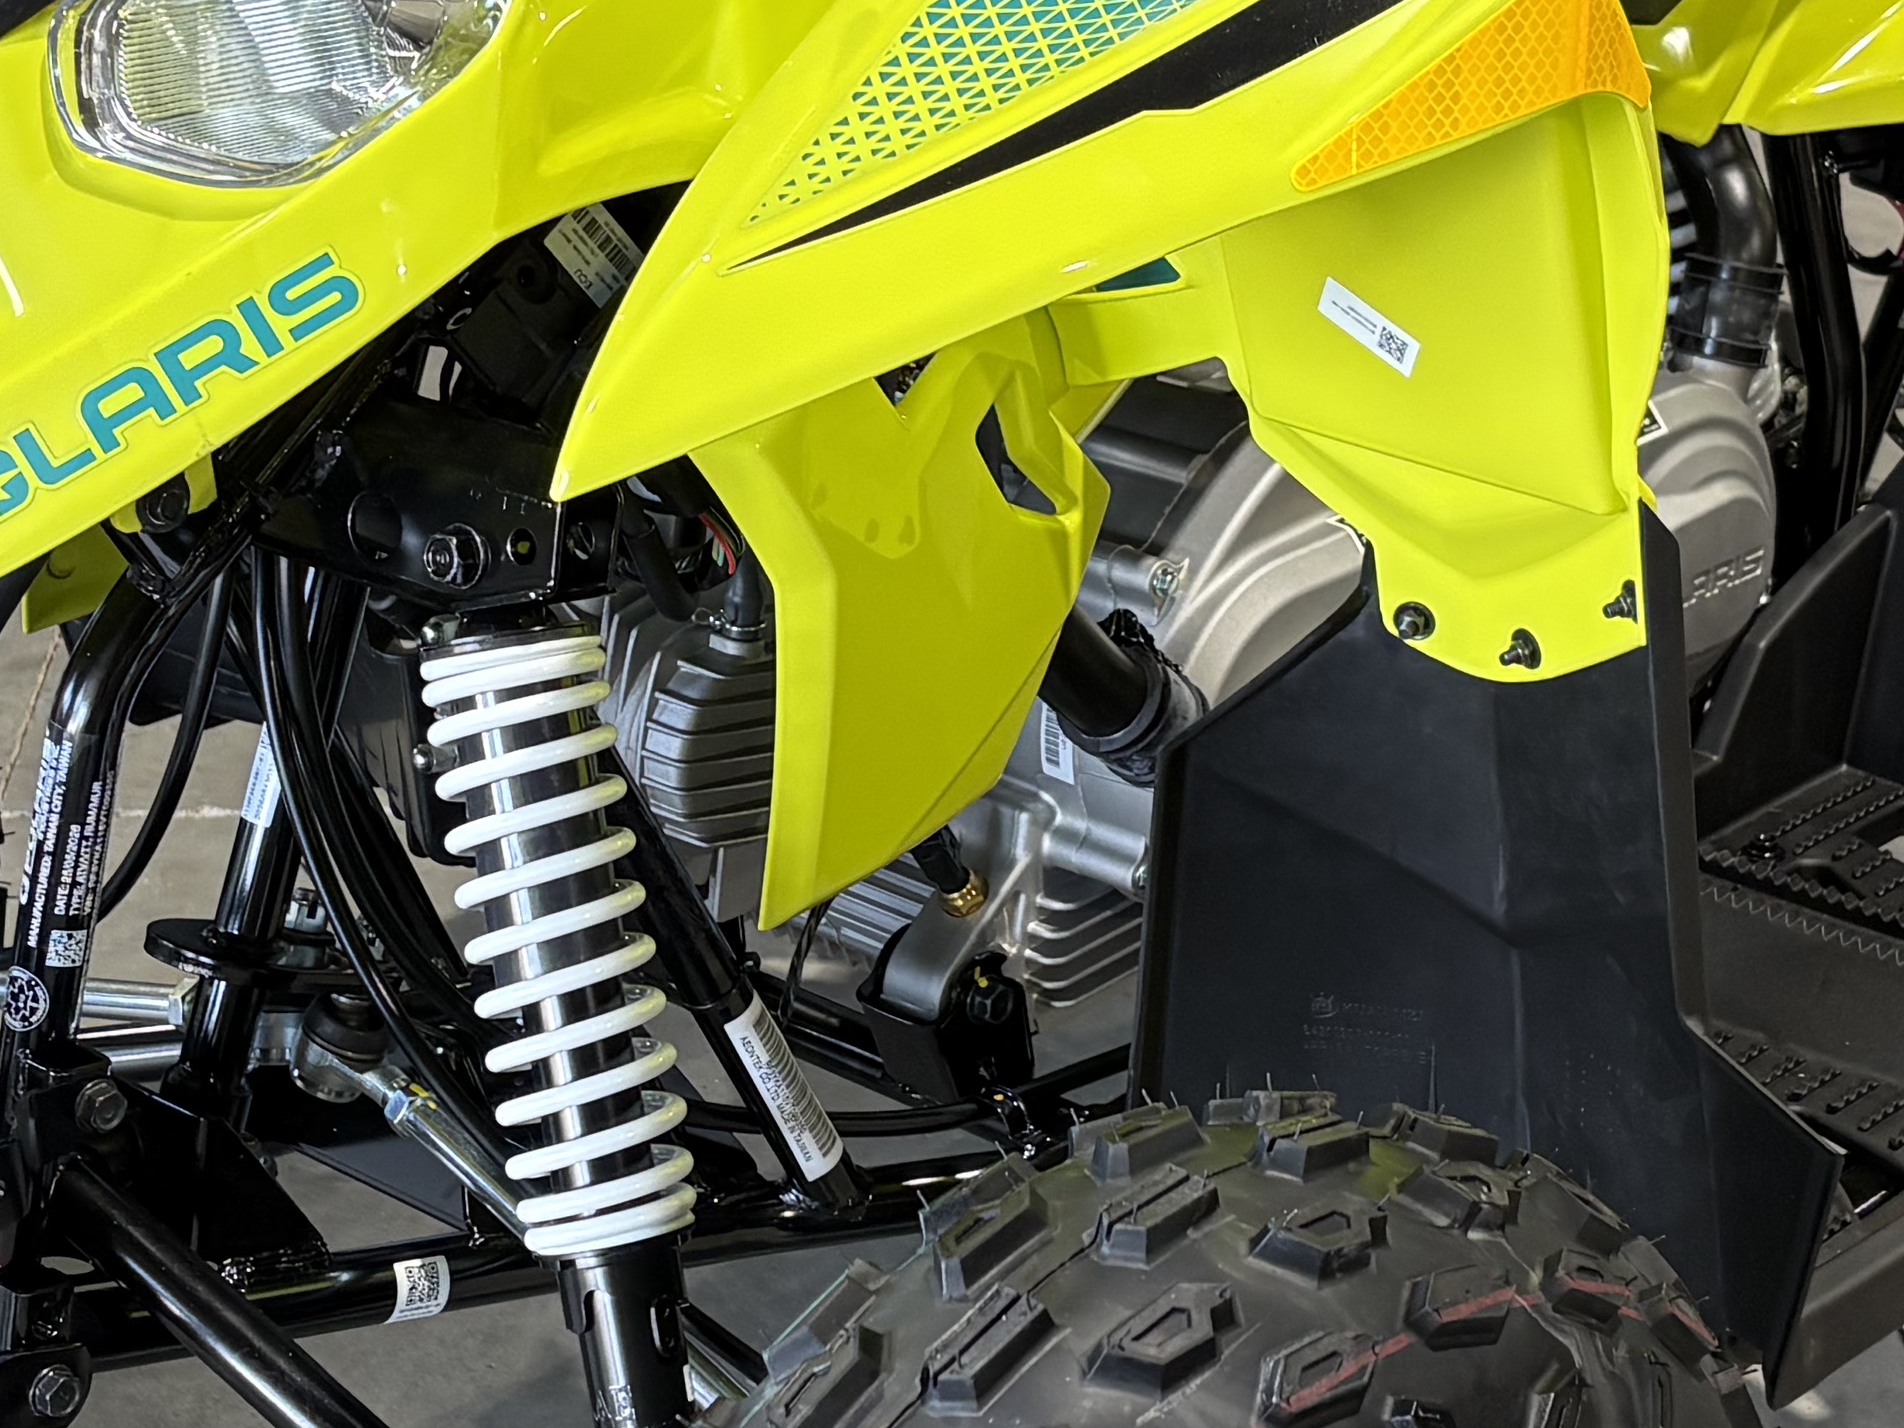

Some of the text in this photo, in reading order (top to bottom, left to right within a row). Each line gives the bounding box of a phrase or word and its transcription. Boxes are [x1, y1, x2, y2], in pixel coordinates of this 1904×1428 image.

[571, 266, 595, 291] ECU
[55, 739, 73, 781] TAIWAN
[51, 783, 66, 812] CITY,
[26, 853, 53, 948] MANUFACTURED:
[54, 882, 70, 915] DATE:
[68, 883, 84, 915] TYPE:
